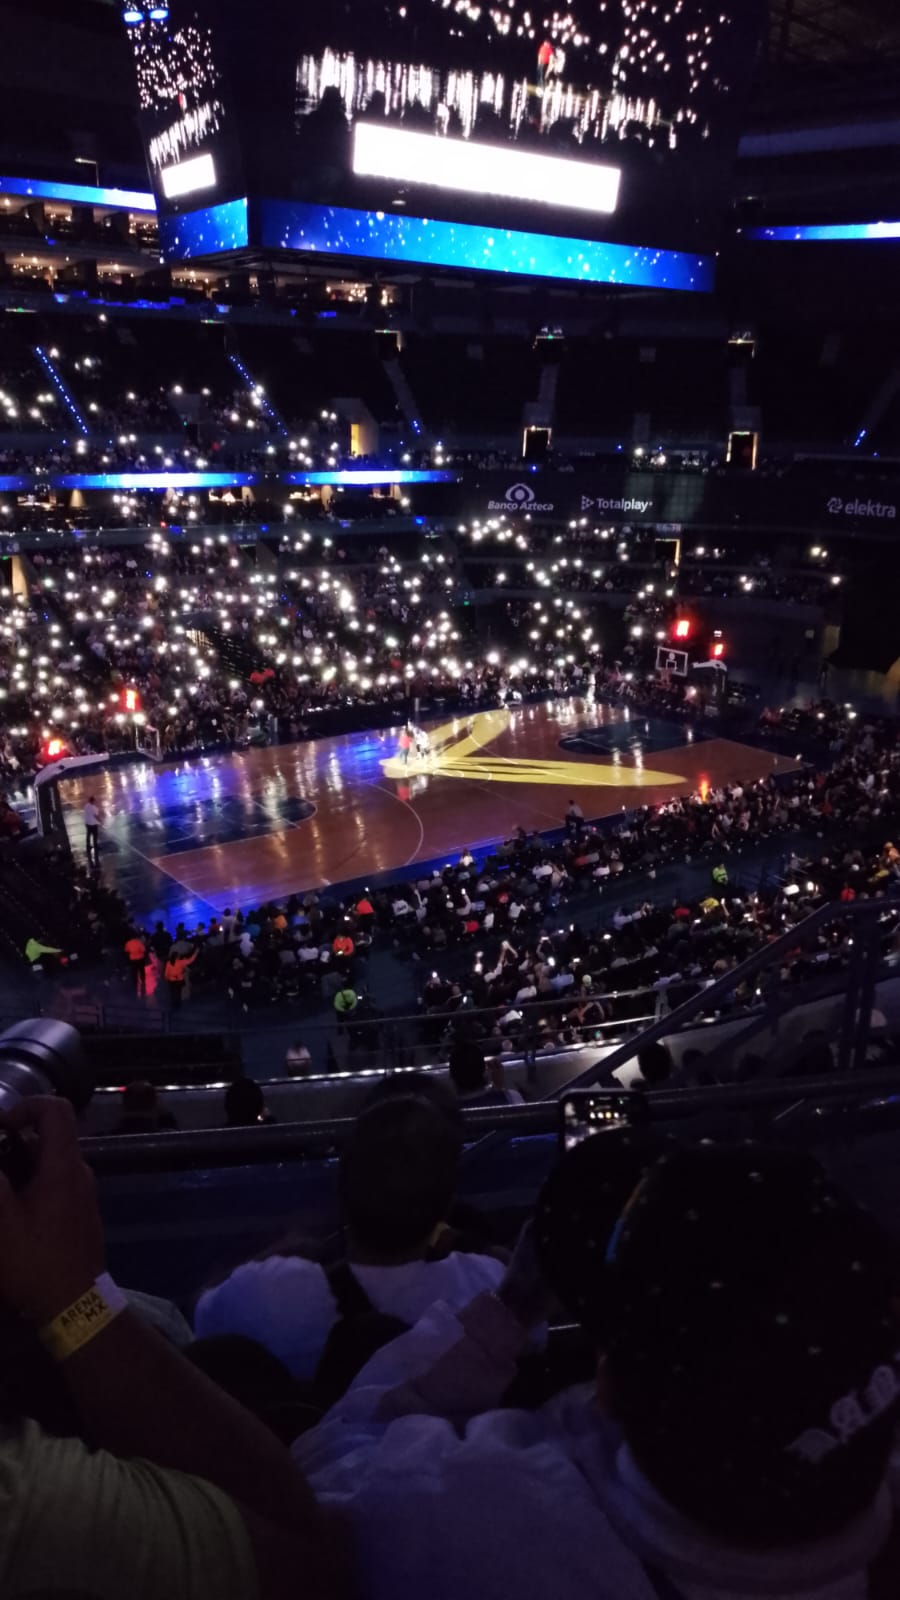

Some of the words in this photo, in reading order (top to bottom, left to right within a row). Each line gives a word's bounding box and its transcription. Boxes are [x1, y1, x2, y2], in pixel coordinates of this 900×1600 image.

[487, 500, 518, 511] Banco
[519, 501, 554, 511] Azteca
[596, 497, 649, 512] Totalplay
[844, 498, 897, 518] elektra
[60, 1291, 100, 1327] ARENA
